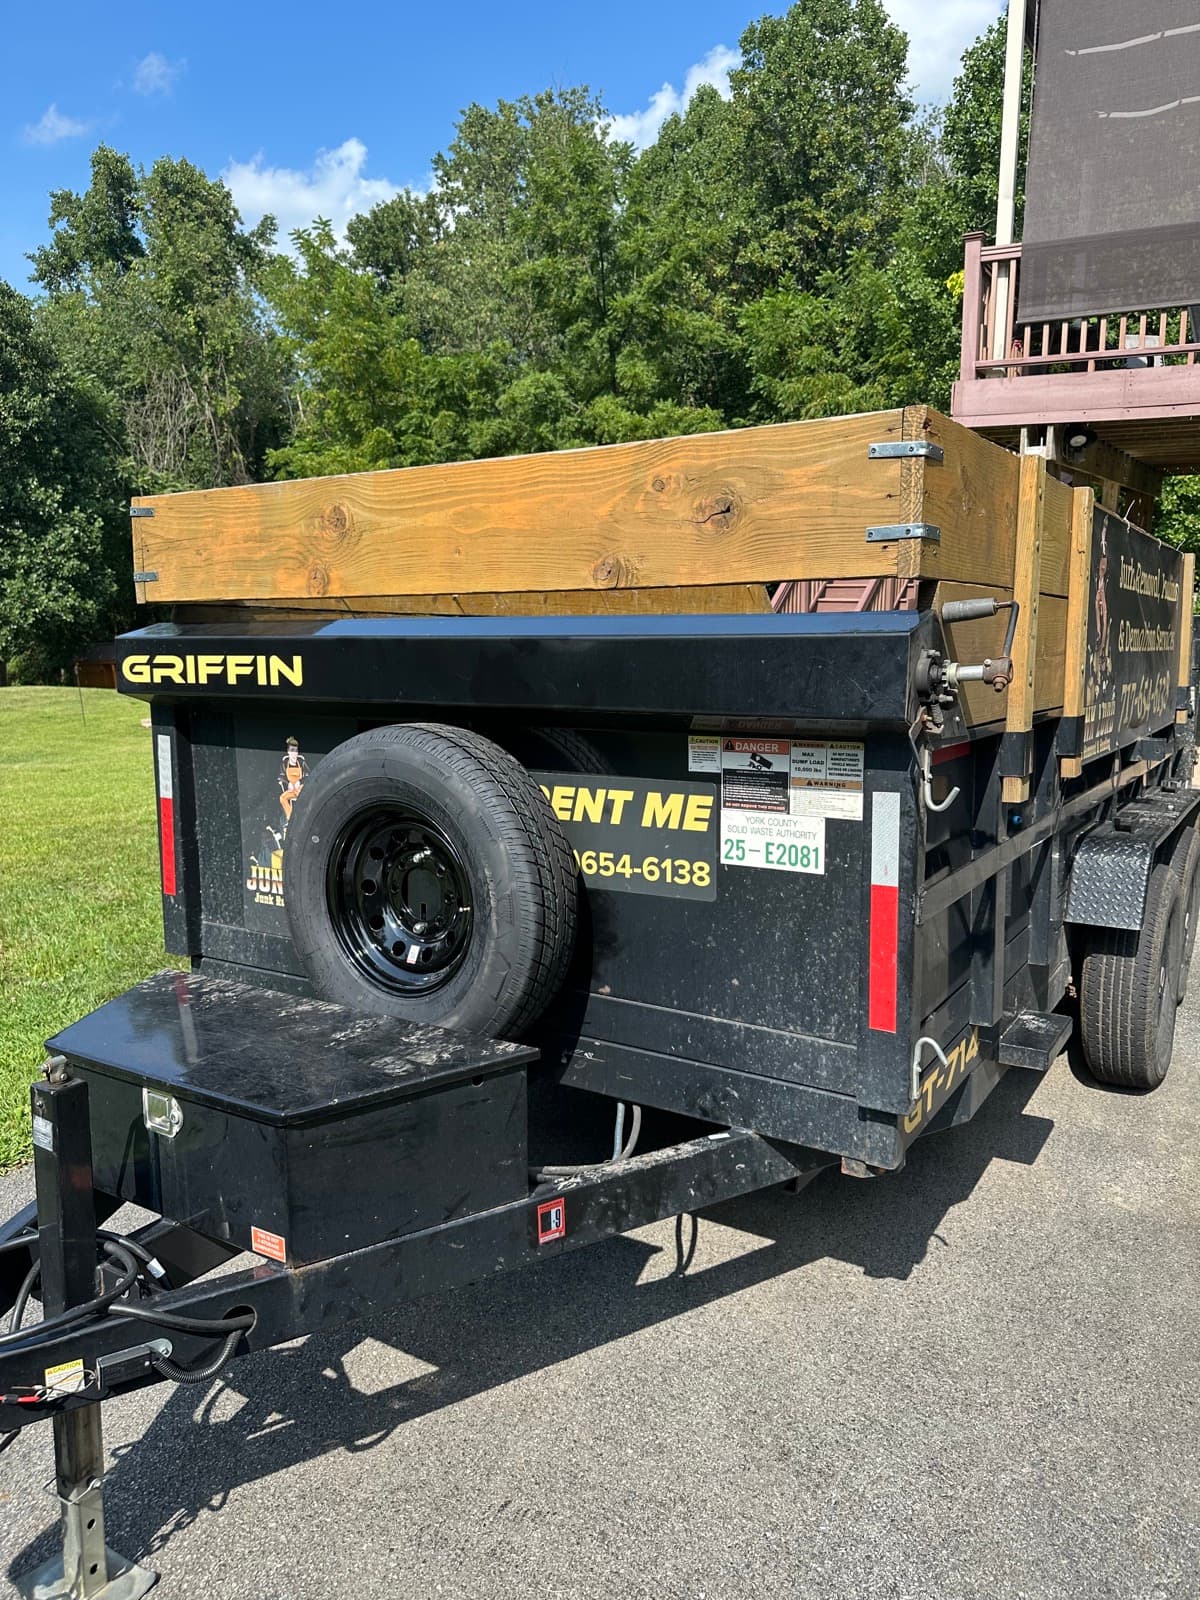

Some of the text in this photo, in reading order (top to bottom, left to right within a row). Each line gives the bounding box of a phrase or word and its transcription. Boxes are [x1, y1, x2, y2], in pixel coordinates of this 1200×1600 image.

[122, 655, 303, 687] GRIFFIN
[695, 738, 719, 746] CAUTION
[735, 742, 779, 752] DANGER
[539, 784, 714, 832] ENT ME
[744, 815, 798, 828] YORK COUNTY
[727, 824, 818, 840] SOLID WASTE AUTHORITY
[254, 892, 274, 905] Junk
[53, 1362, 81, 1373] CAUTION
